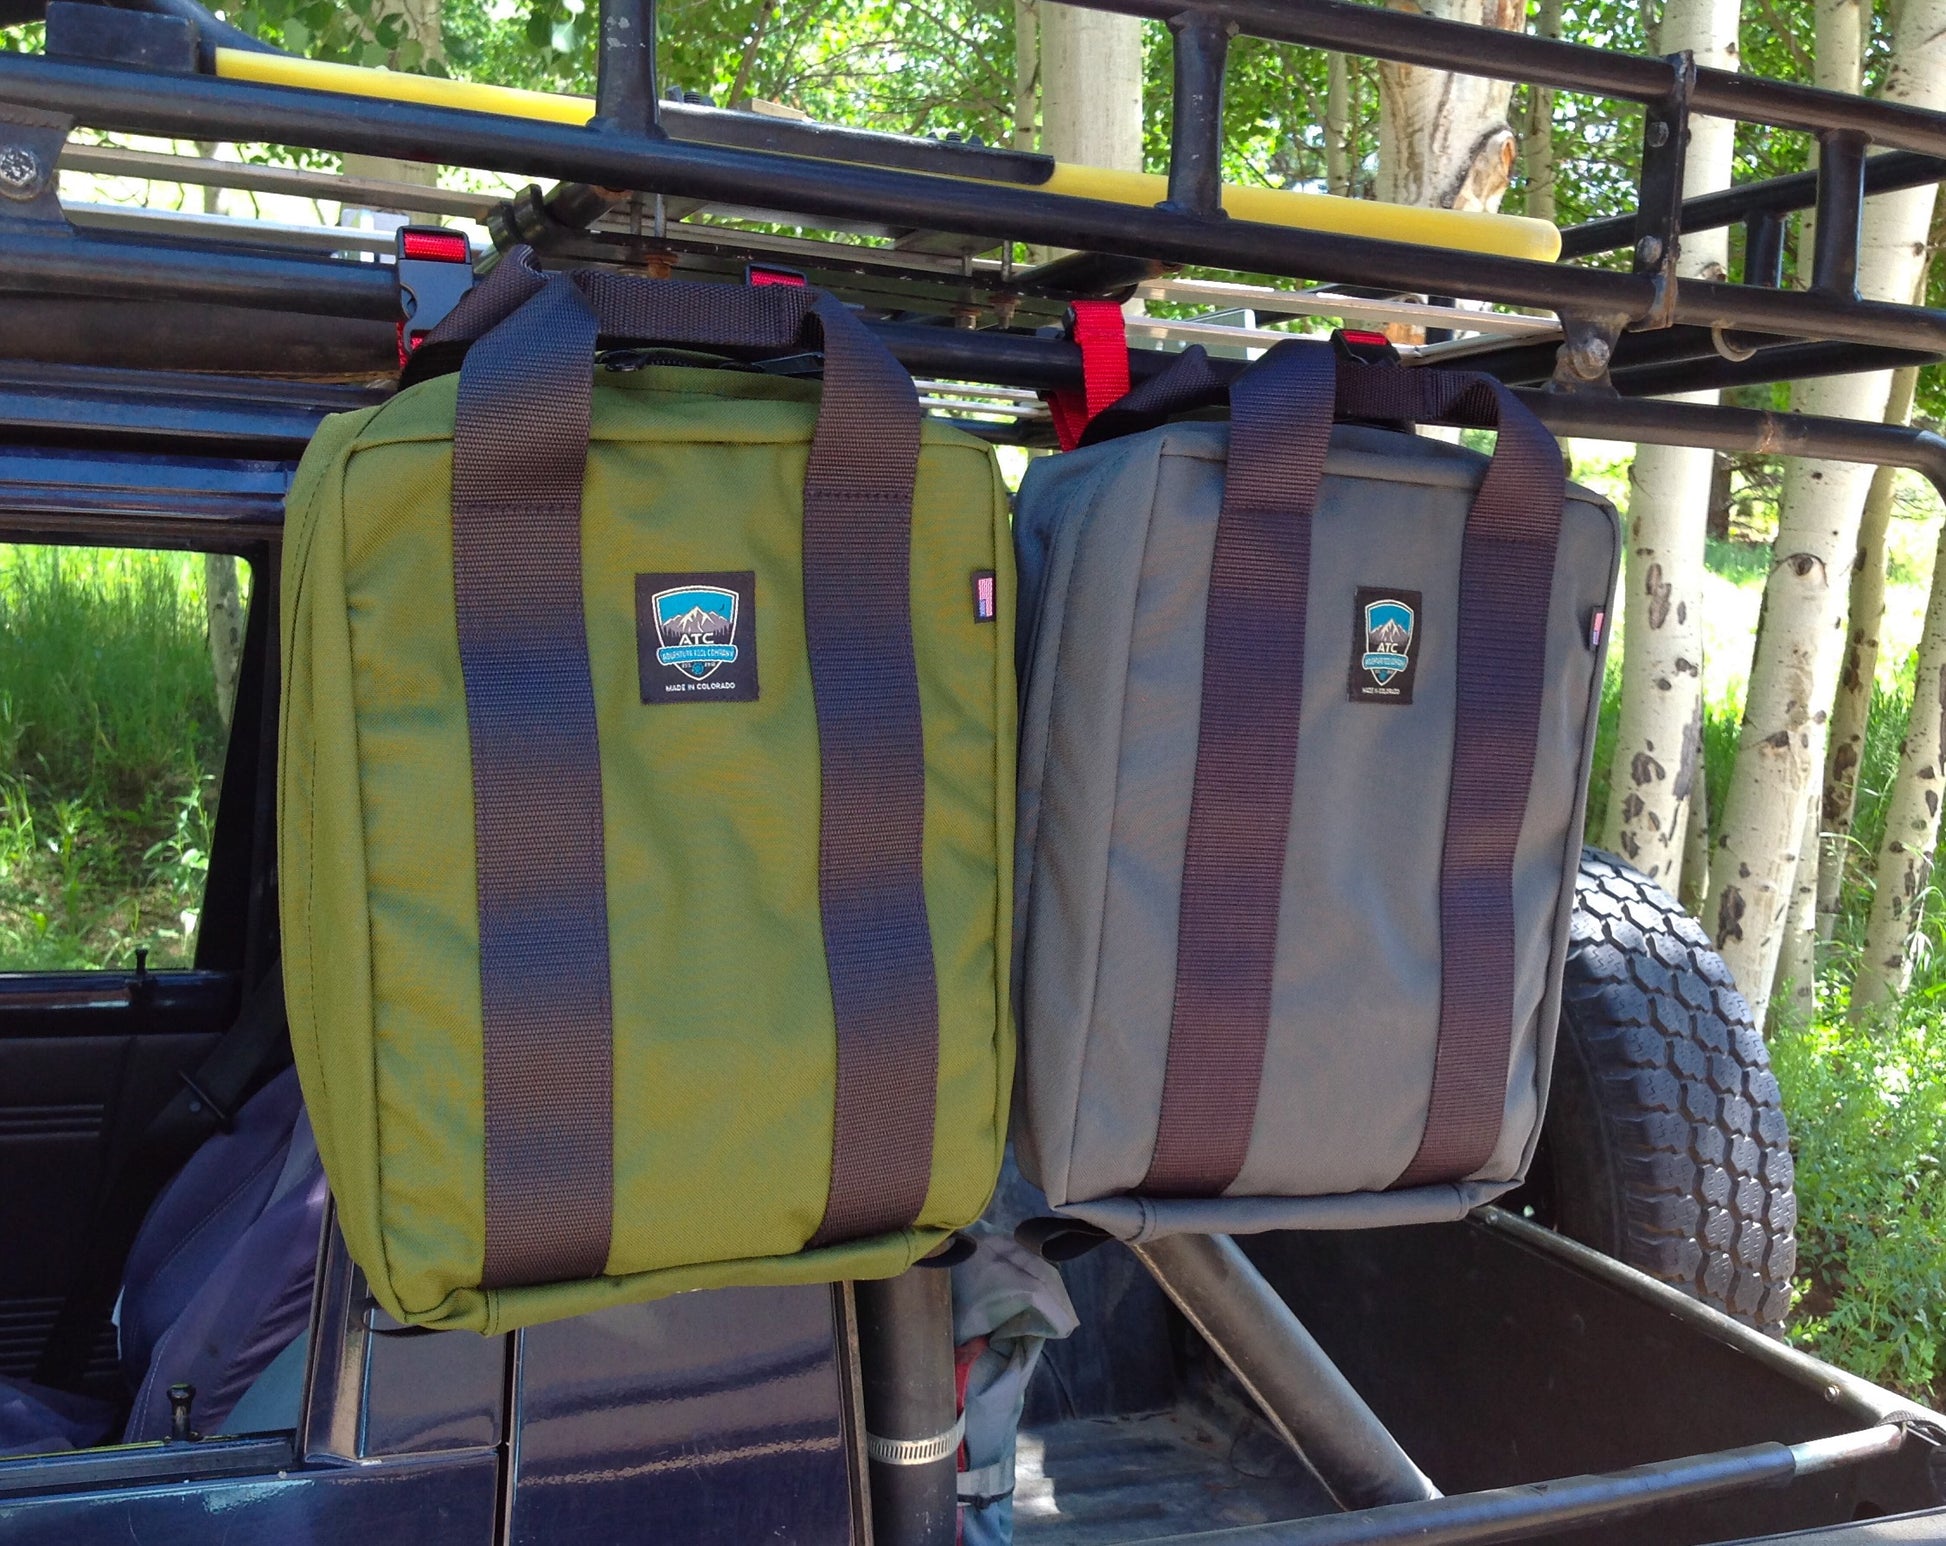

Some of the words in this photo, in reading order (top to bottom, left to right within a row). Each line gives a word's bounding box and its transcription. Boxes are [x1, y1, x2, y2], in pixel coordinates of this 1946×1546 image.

[679, 632, 714, 646] ATC
[1376, 642, 1399, 653] ATC
[665, 683, 686, 692] MADE
[696, 682, 736, 690] COLORADO
